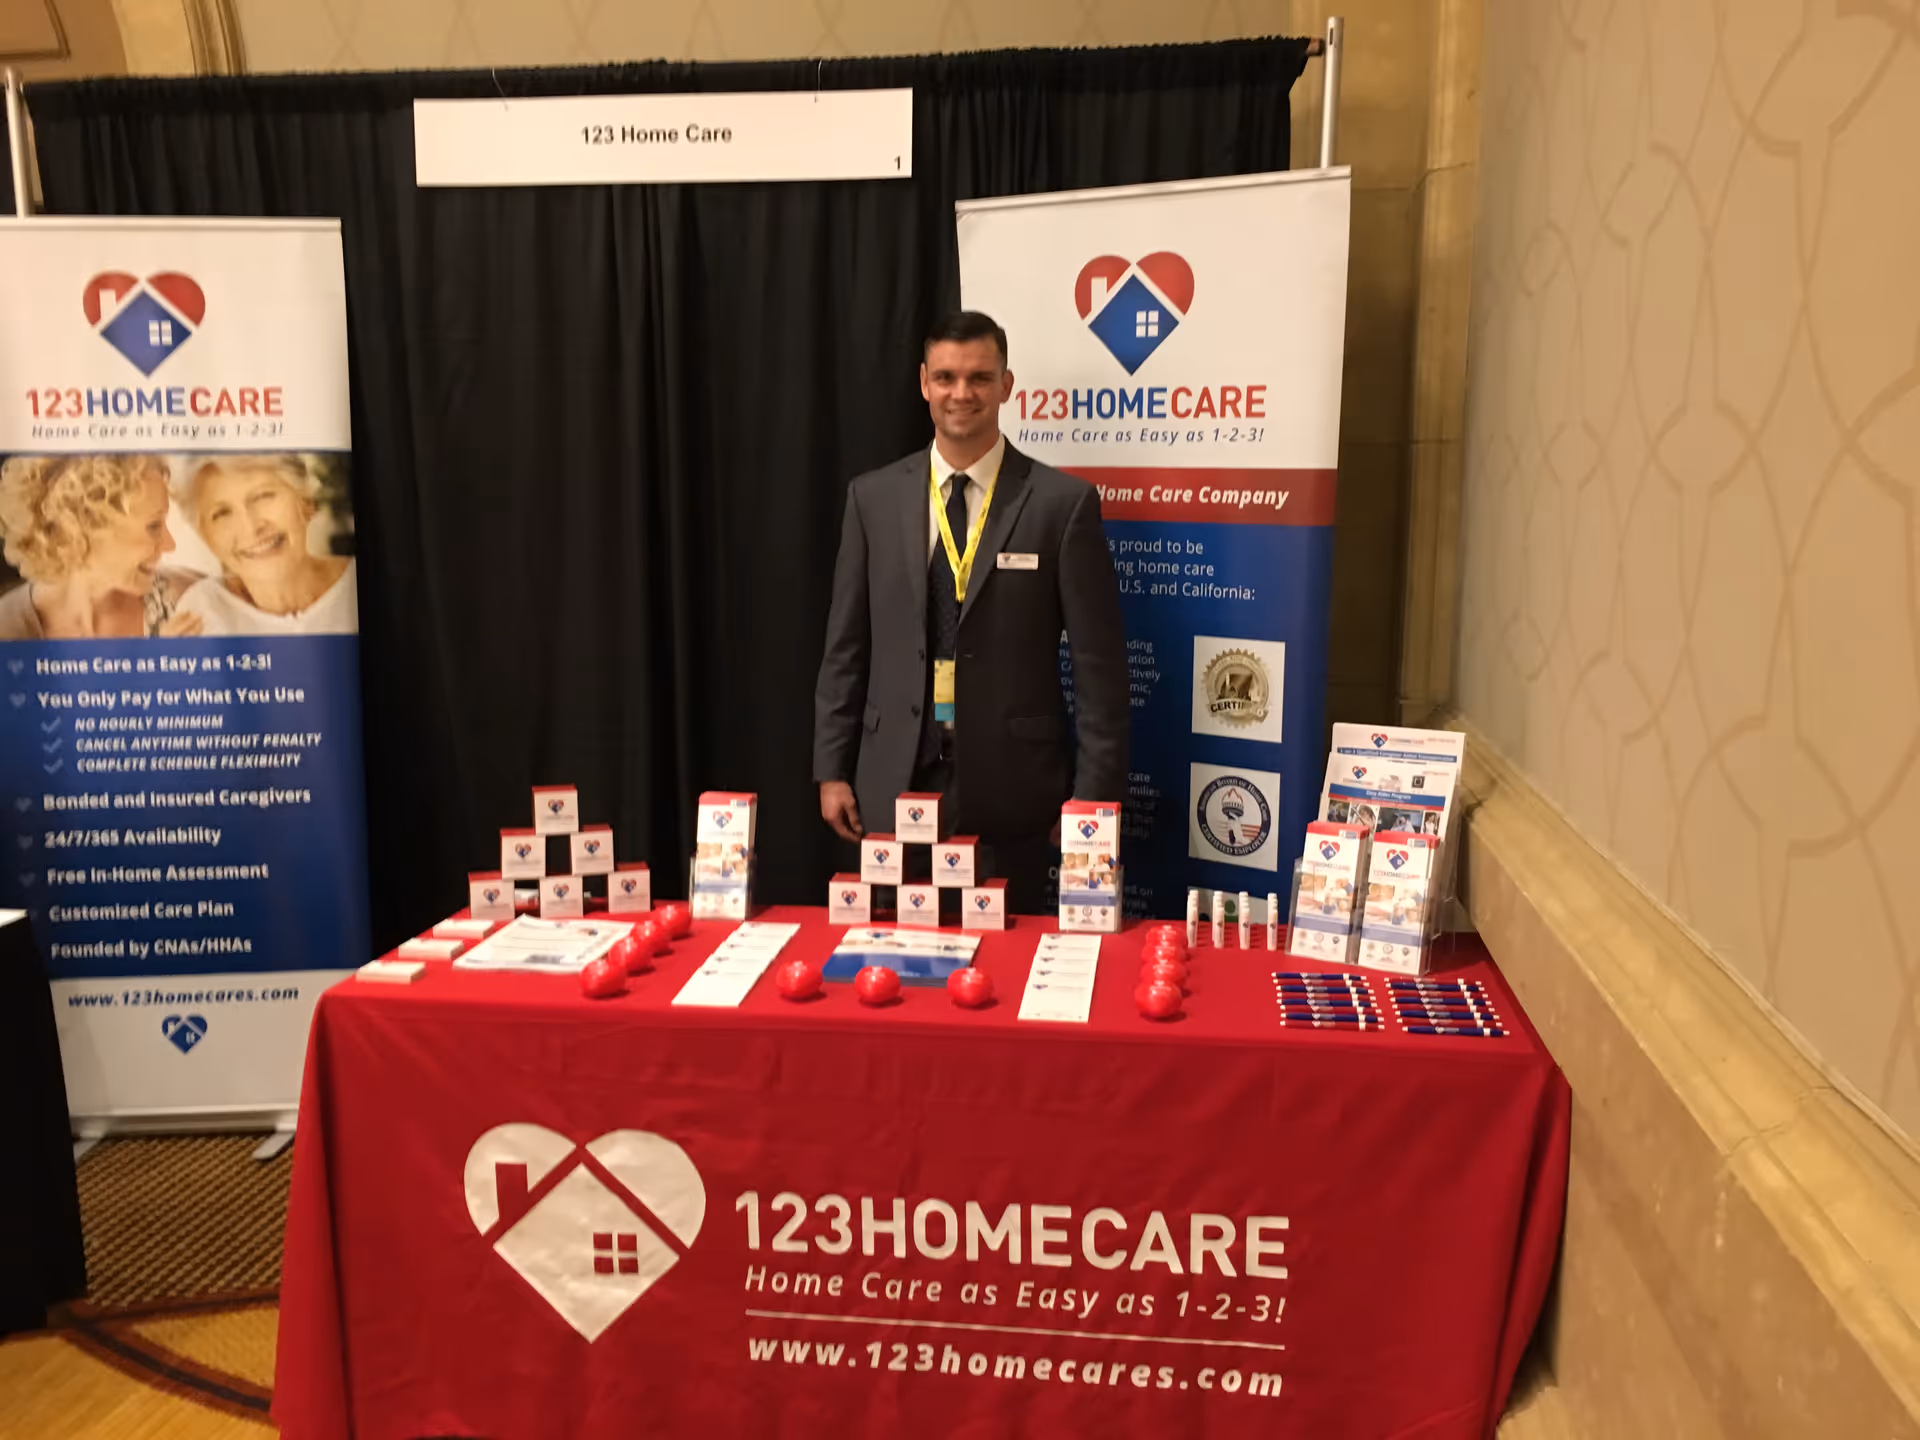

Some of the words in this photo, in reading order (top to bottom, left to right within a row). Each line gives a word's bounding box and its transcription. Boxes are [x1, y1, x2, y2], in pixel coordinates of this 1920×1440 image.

[581, 125, 614, 144] 123
[621, 124, 679, 144] Home
[685, 123, 733, 143] Care
[894, 156, 902, 170] 1
[26, 386, 284, 419] 123HOMECARE
[1015, 384, 1267, 421] 123HOMECARE
[32, 424, 80, 438] Home
[88, 423, 127, 437] Care
[135, 425, 153, 437] as
[161, 423, 200, 440] Easy
[208, 424, 226, 437] as
[1019, 428, 1064, 442] Home
[1071, 428, 1108, 442] Care
[1115, 430, 1132, 442] as
[1139, 428, 1178, 446] Easy
[1186, 430, 1204, 442] as
[1212, 427, 1265, 443] 1-2-3!
[1150, 485, 1193, 503] Care
[1199, 486, 1289, 510] Company
[1120, 537, 1161, 555] proud
[1167, 540, 1181, 554] to
[1186, 539, 1203, 554] be
[1138, 559, 1179, 575] home
[1184, 563, 1214, 577] care
[1119, 579, 1145, 594] U.S.
[1150, 581, 1177, 596] and
[1182, 582, 1255, 600] California:
[36, 658, 88, 675] Home
[93, 657, 131, 673] Care
[137, 658, 155, 672] as
[160, 655, 197, 675] Easy
[202, 657, 220, 670] as
[37, 692, 73, 708] You
[78, 690, 116, 711] Only
[121, 689, 151, 710] Pay
[157, 688, 180, 705] for
[186, 688, 232, 705] What
[237, 688, 270, 703] You
[275, 687, 305, 703] Use
[75, 717, 95, 732] NO
[157, 714, 223, 730] MINIMUM
[76, 738, 127, 752] CANCEL
[131, 735, 192, 751] ANYTIME
[196, 733, 260, 749] WITHOUT
[263, 732, 322, 747] PENALTY
[77, 756, 147, 773] COMPLETE
[150, 754, 217, 771] SCHEDULE
[221, 752, 301, 769] FLEXIBILITY
[43, 793, 109, 811] Bonded
[114, 791, 146, 809] and
[150, 789, 215, 808] Insured
[219, 787, 311, 808] Caregivers
[45, 829, 119, 848] 24/7/365
[124, 826, 221, 847] Availability
[47, 867, 86, 886] Free
[90, 864, 162, 884] In-Home
[166, 863, 270, 882] Assessment
[49, 902, 150, 922] Customized
[154, 902, 193, 919] Care
[197, 900, 234, 917] Plan
[51, 940, 124, 959] Founded
[129, 939, 149, 959] by
[153, 936, 252, 956] CNAs/HHAs
[68, 987, 299, 1008] www.123homecares.com
[735, 1190, 1290, 1279] 123HOMECARE
[744, 1264, 844, 1298] Home
[861, 1271, 943, 1303] Care
[960, 1280, 998, 1307] as
[1015, 1279, 1099, 1320] Easy
[1116, 1291, 1155, 1317] as
[1175, 1289, 1287, 1324] 1-2-3!
[748, 1336, 1283, 1398] www.123homecares.com
